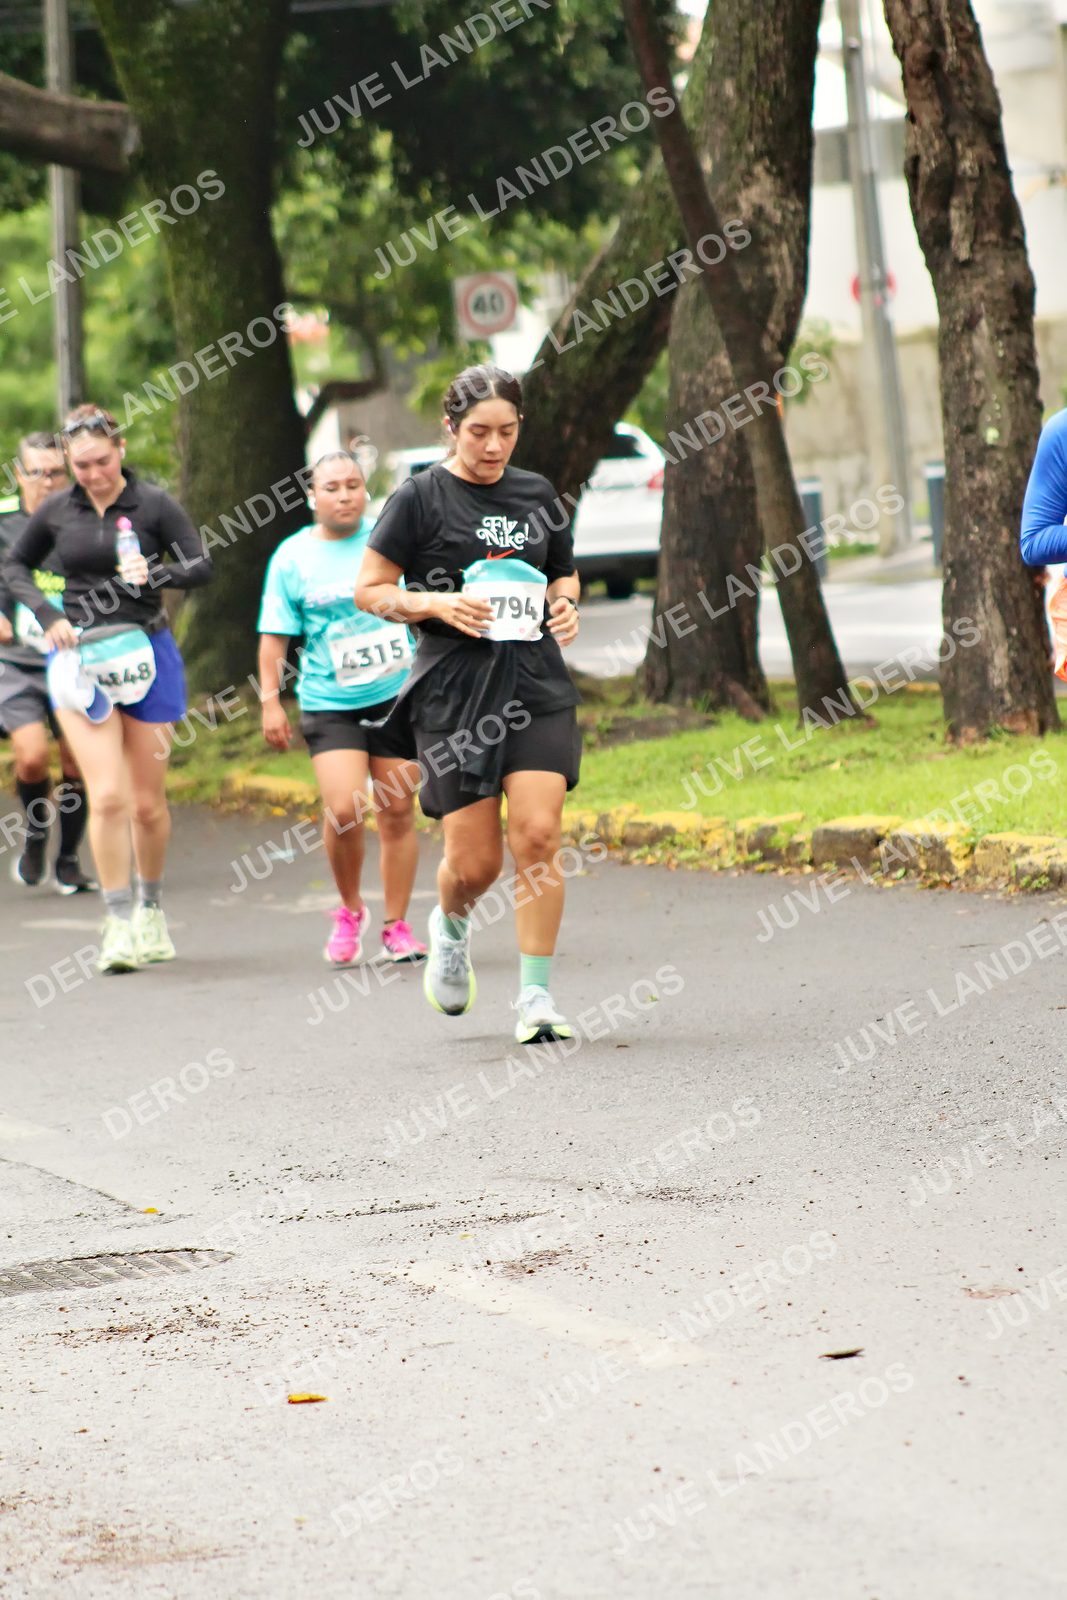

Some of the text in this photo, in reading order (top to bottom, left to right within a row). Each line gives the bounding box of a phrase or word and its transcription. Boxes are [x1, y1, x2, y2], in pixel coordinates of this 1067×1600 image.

[473, 291, 504, 317] 40
[476, 523, 529, 550] Nike!
[482, 516, 518, 534] Fly
[342, 638, 404, 669] 4315
